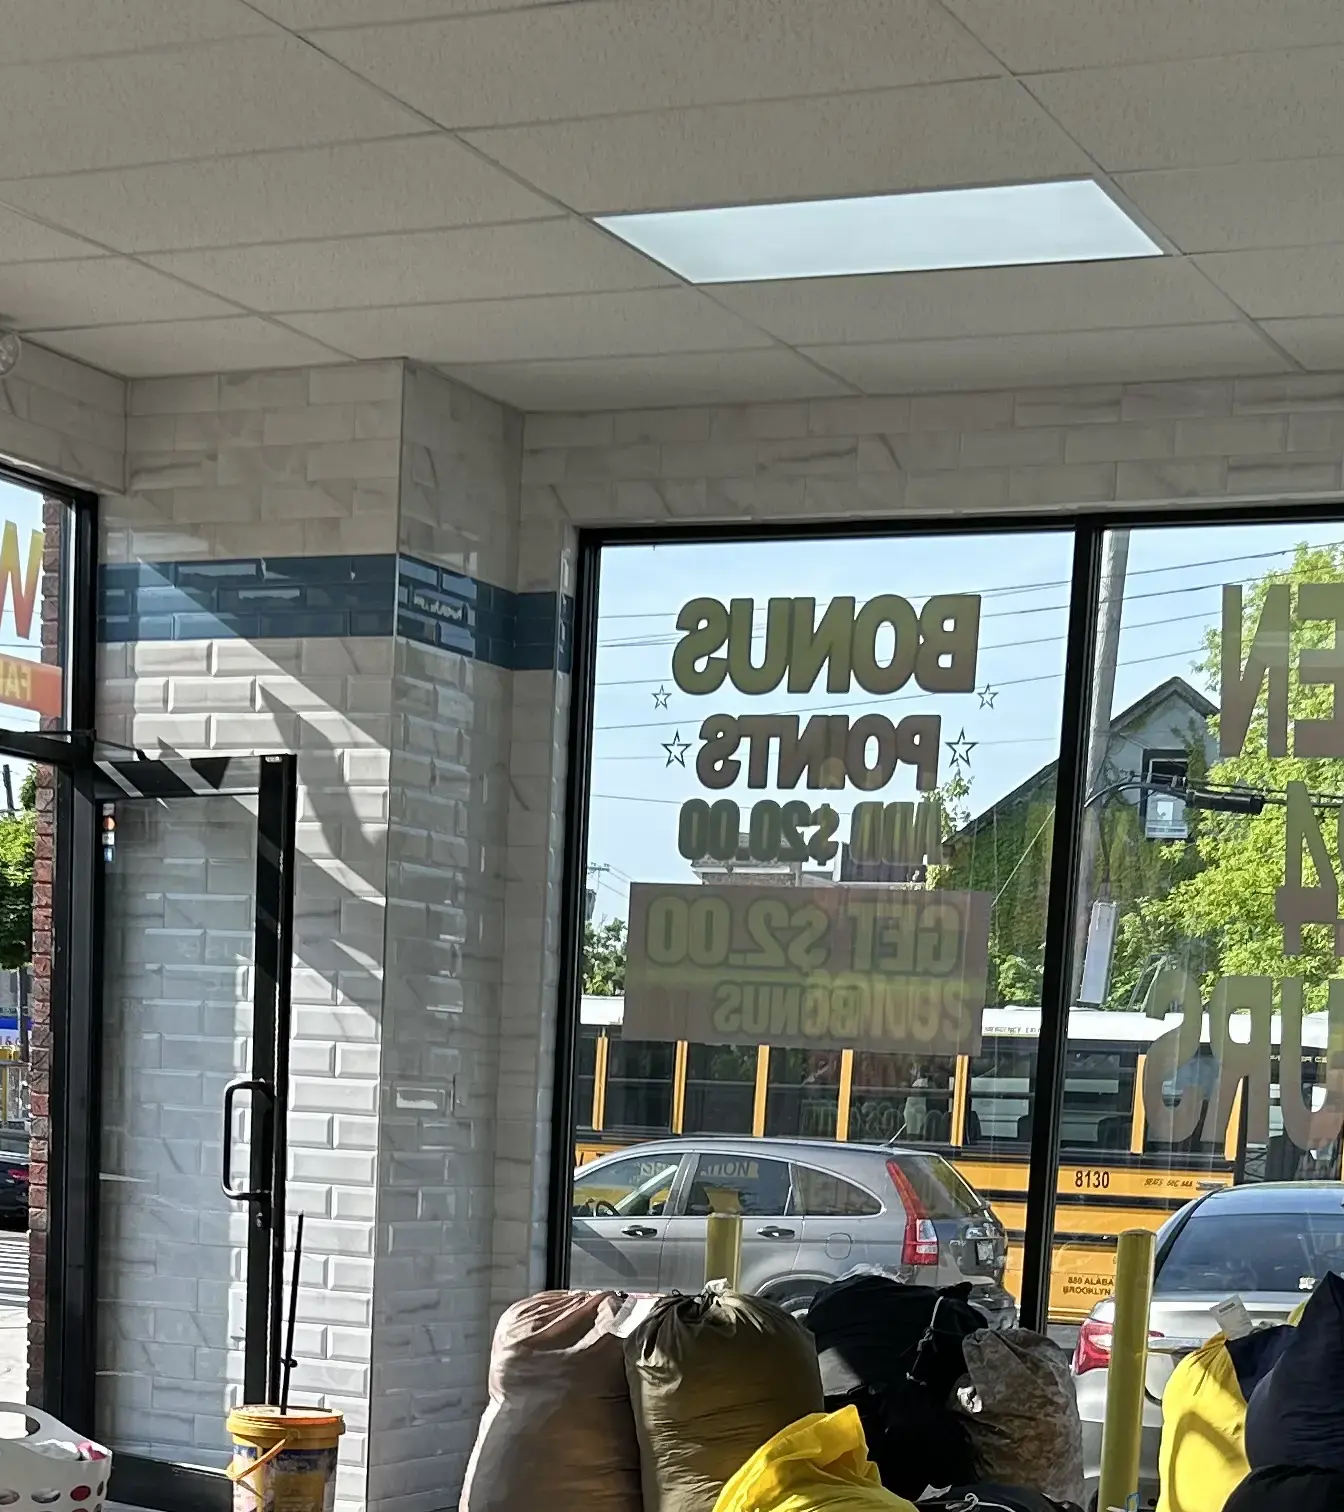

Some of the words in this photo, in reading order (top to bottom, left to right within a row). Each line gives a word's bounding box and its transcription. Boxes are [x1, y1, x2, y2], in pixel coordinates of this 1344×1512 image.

[1074, 1170, 1110, 1189] 8130
[1083, 1276, 1115, 1286] ALABA
[1062, 1286, 1111, 1296] BROOKLYN
